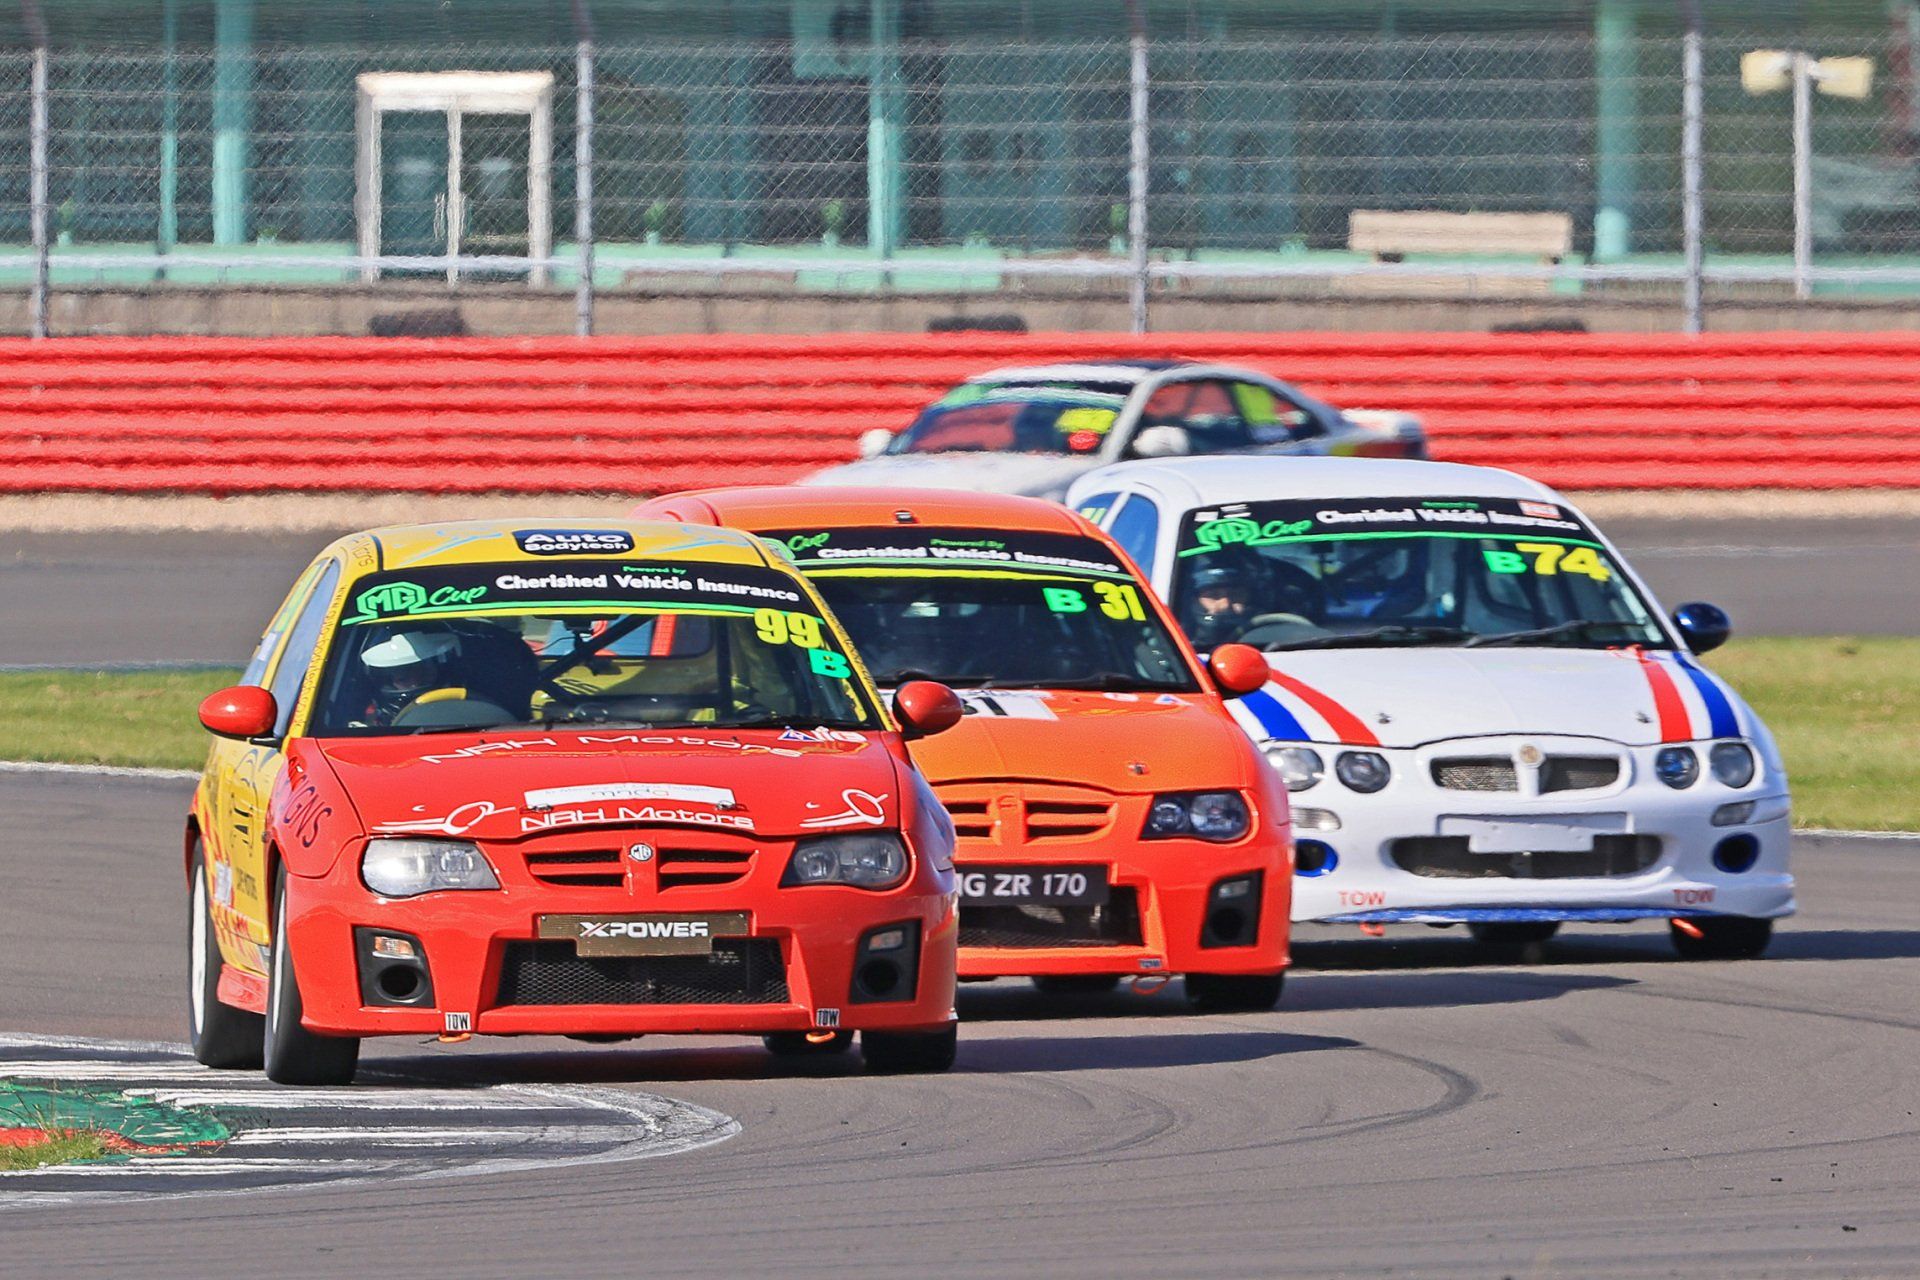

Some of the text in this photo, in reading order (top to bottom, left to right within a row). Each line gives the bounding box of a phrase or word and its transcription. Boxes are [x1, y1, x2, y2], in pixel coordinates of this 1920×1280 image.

[524, 533, 626, 543] Auto
[524, 541, 630, 552] Bodytech
[622, 565, 687, 575] Powered by
[817, 546, 1120, 572] Cherished Vehicle Insurance
[1484, 542, 1609, 580] B 74
[361, 583, 489, 614] MG Cup
[495, 573, 800, 602] Cherished Vehicle Insurance
[1042, 581, 1146, 621] B 31
[754, 608, 822, 648] 99
[808, 648, 851, 679] B
[577, 735, 803, 758] Motors
[617, 805, 756, 831] Motors
[992, 873, 1033, 896] ZR
[1042, 873, 1088, 897] 170
[1338, 890, 1385, 906] TOW
[1673, 889, 1716, 905] TOW
[577, 920, 710, 938] XPOWER
[446, 1014, 470, 1031] TOW
[817, 1011, 840, 1027] TOW
